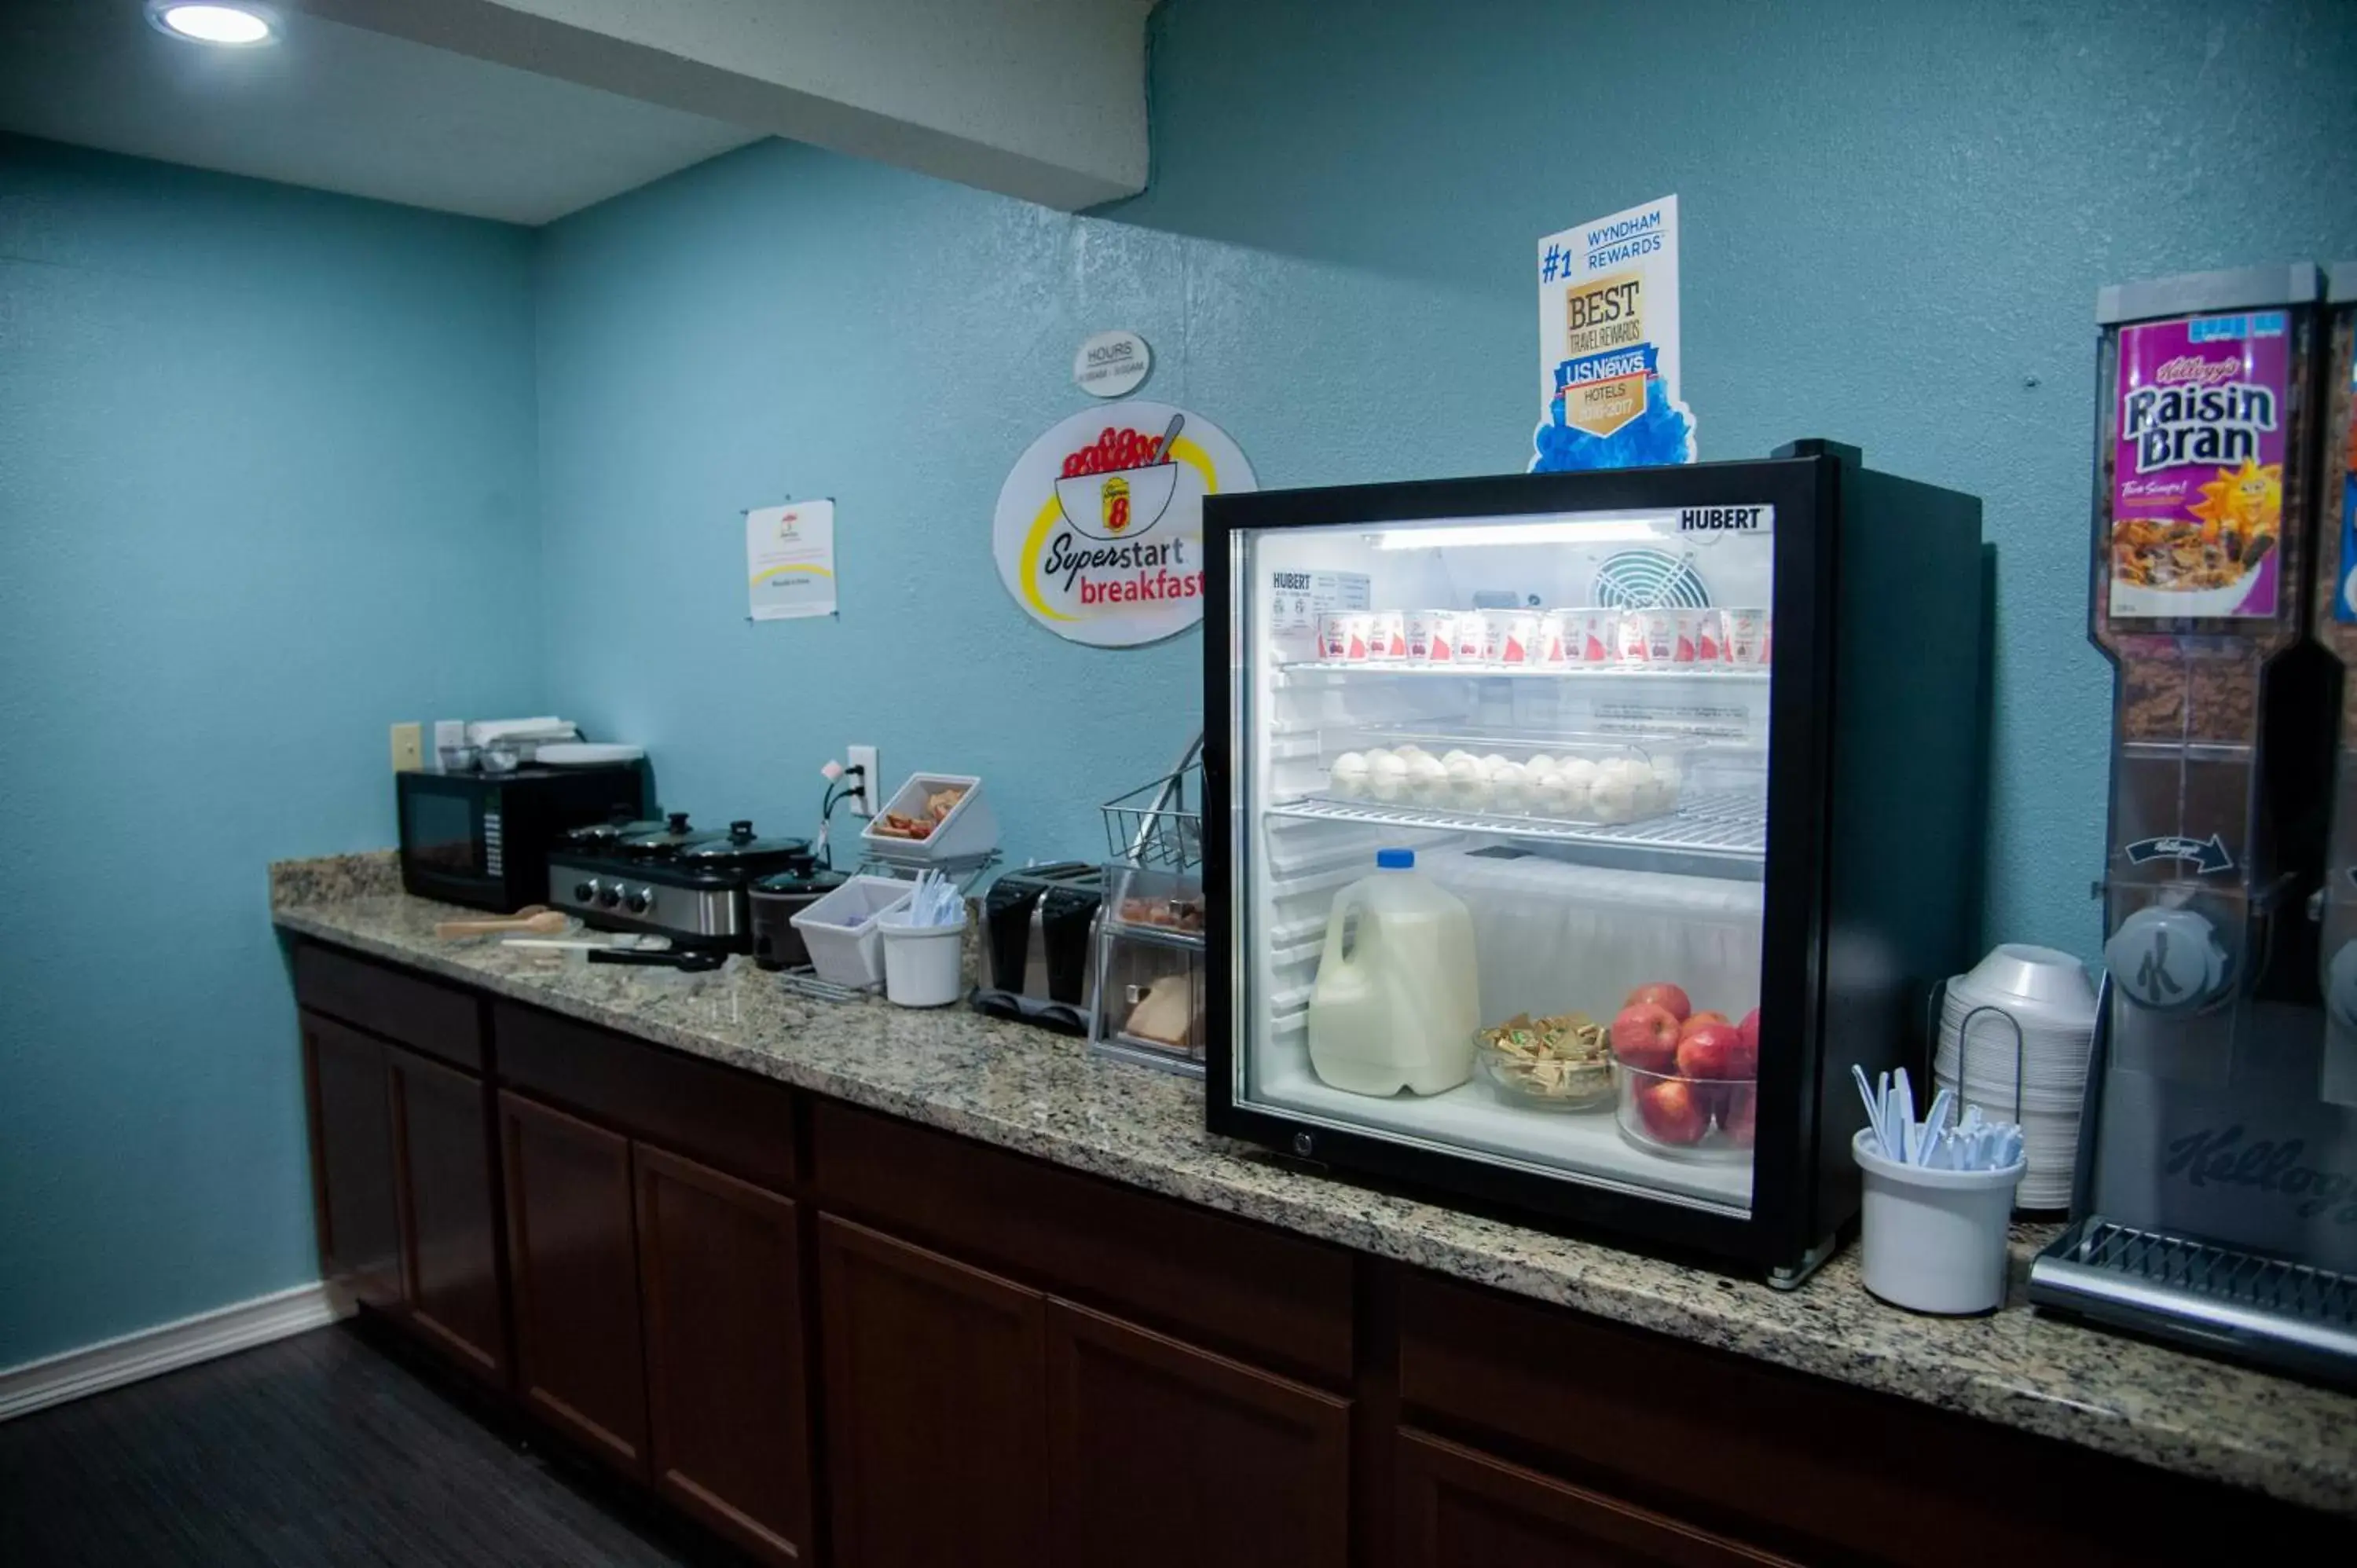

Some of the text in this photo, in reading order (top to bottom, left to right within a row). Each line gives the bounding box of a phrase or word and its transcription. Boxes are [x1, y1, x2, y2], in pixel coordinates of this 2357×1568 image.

[1588, 210, 1661, 246] WYNDHAM
[1542, 244, 1572, 284] #1
[1589, 238, 1662, 270] REWARDS
[1570, 281, 1640, 330] BEST
[1087, 341, 1132, 362] HOURS
[1571, 319, 1640, 354] TRAVEL REWARDS
[2157, 355, 2240, 383] Kellogg's
[1585, 383, 1626, 402] HOTELS
[2126, 383, 2274, 436] Raisin
[2139, 424, 2255, 470] Bran
[1109, 498, 1127, 529] 8
[1681, 508, 1761, 530] HUBERT
[1044, 532, 1185, 592] Superstart
[1081, 570, 1204, 604] breakfast
[1273, 572, 1311, 591] HUBERT
